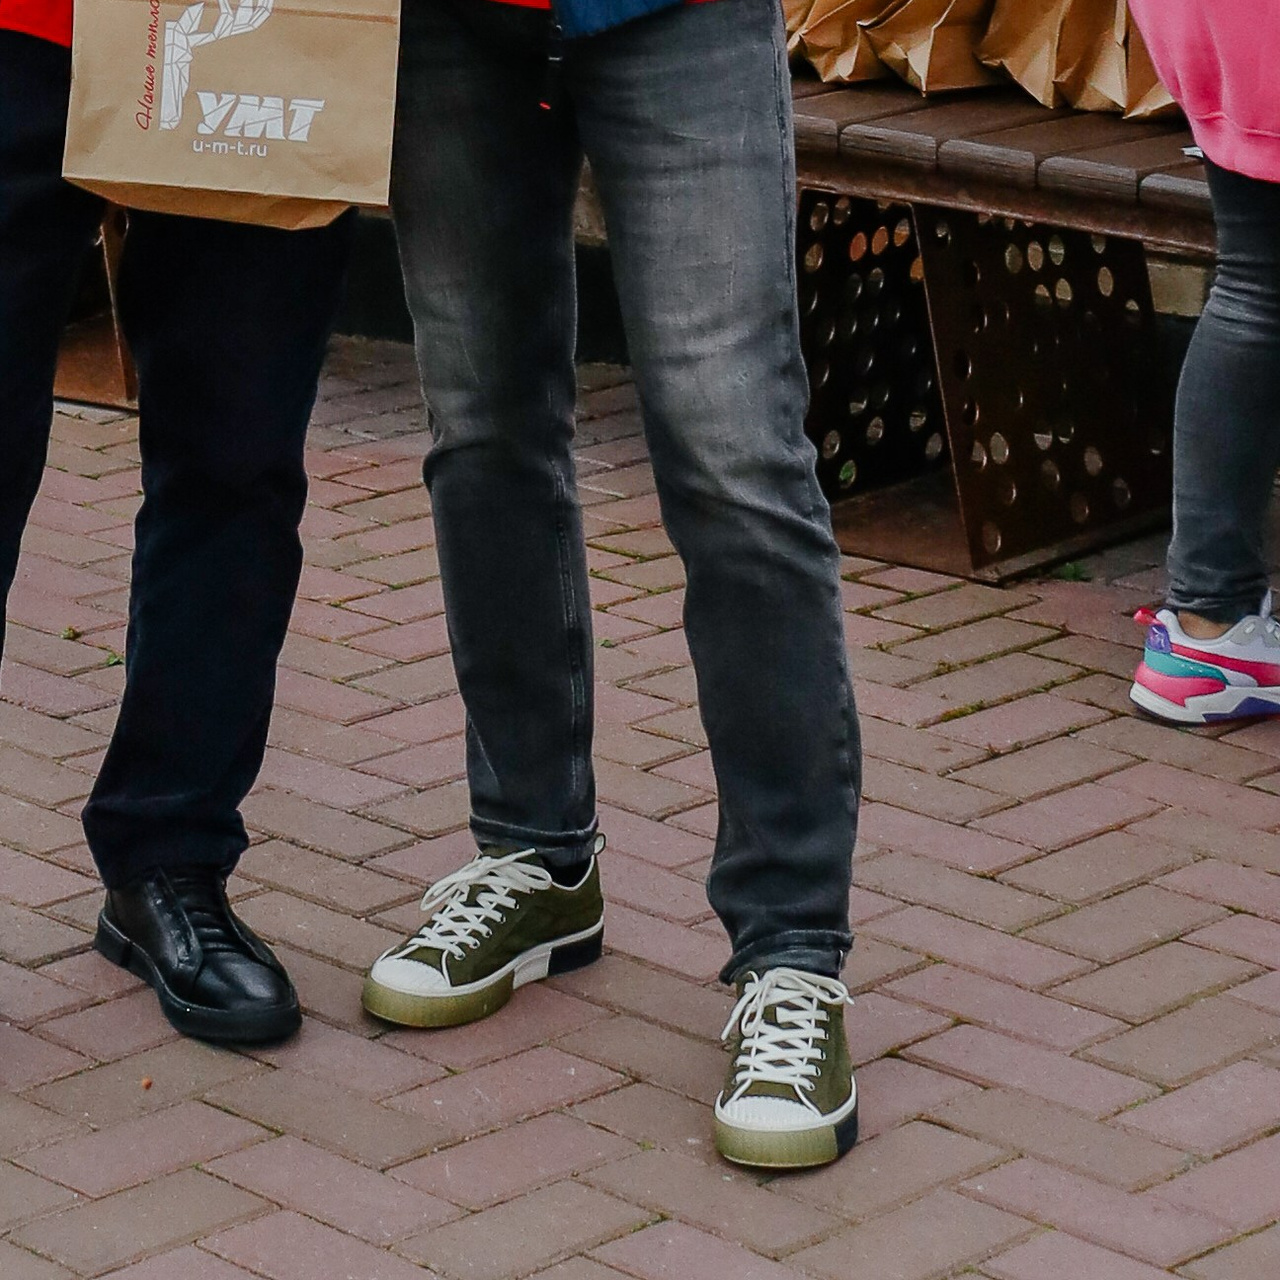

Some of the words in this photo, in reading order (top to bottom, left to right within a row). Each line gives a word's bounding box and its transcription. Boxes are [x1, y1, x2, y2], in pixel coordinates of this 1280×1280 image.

[135, 63, 156, 131] Наше
[196, 91, 326, 142] УМТ
[193, 140, 268, 157] u-m-t.ru
